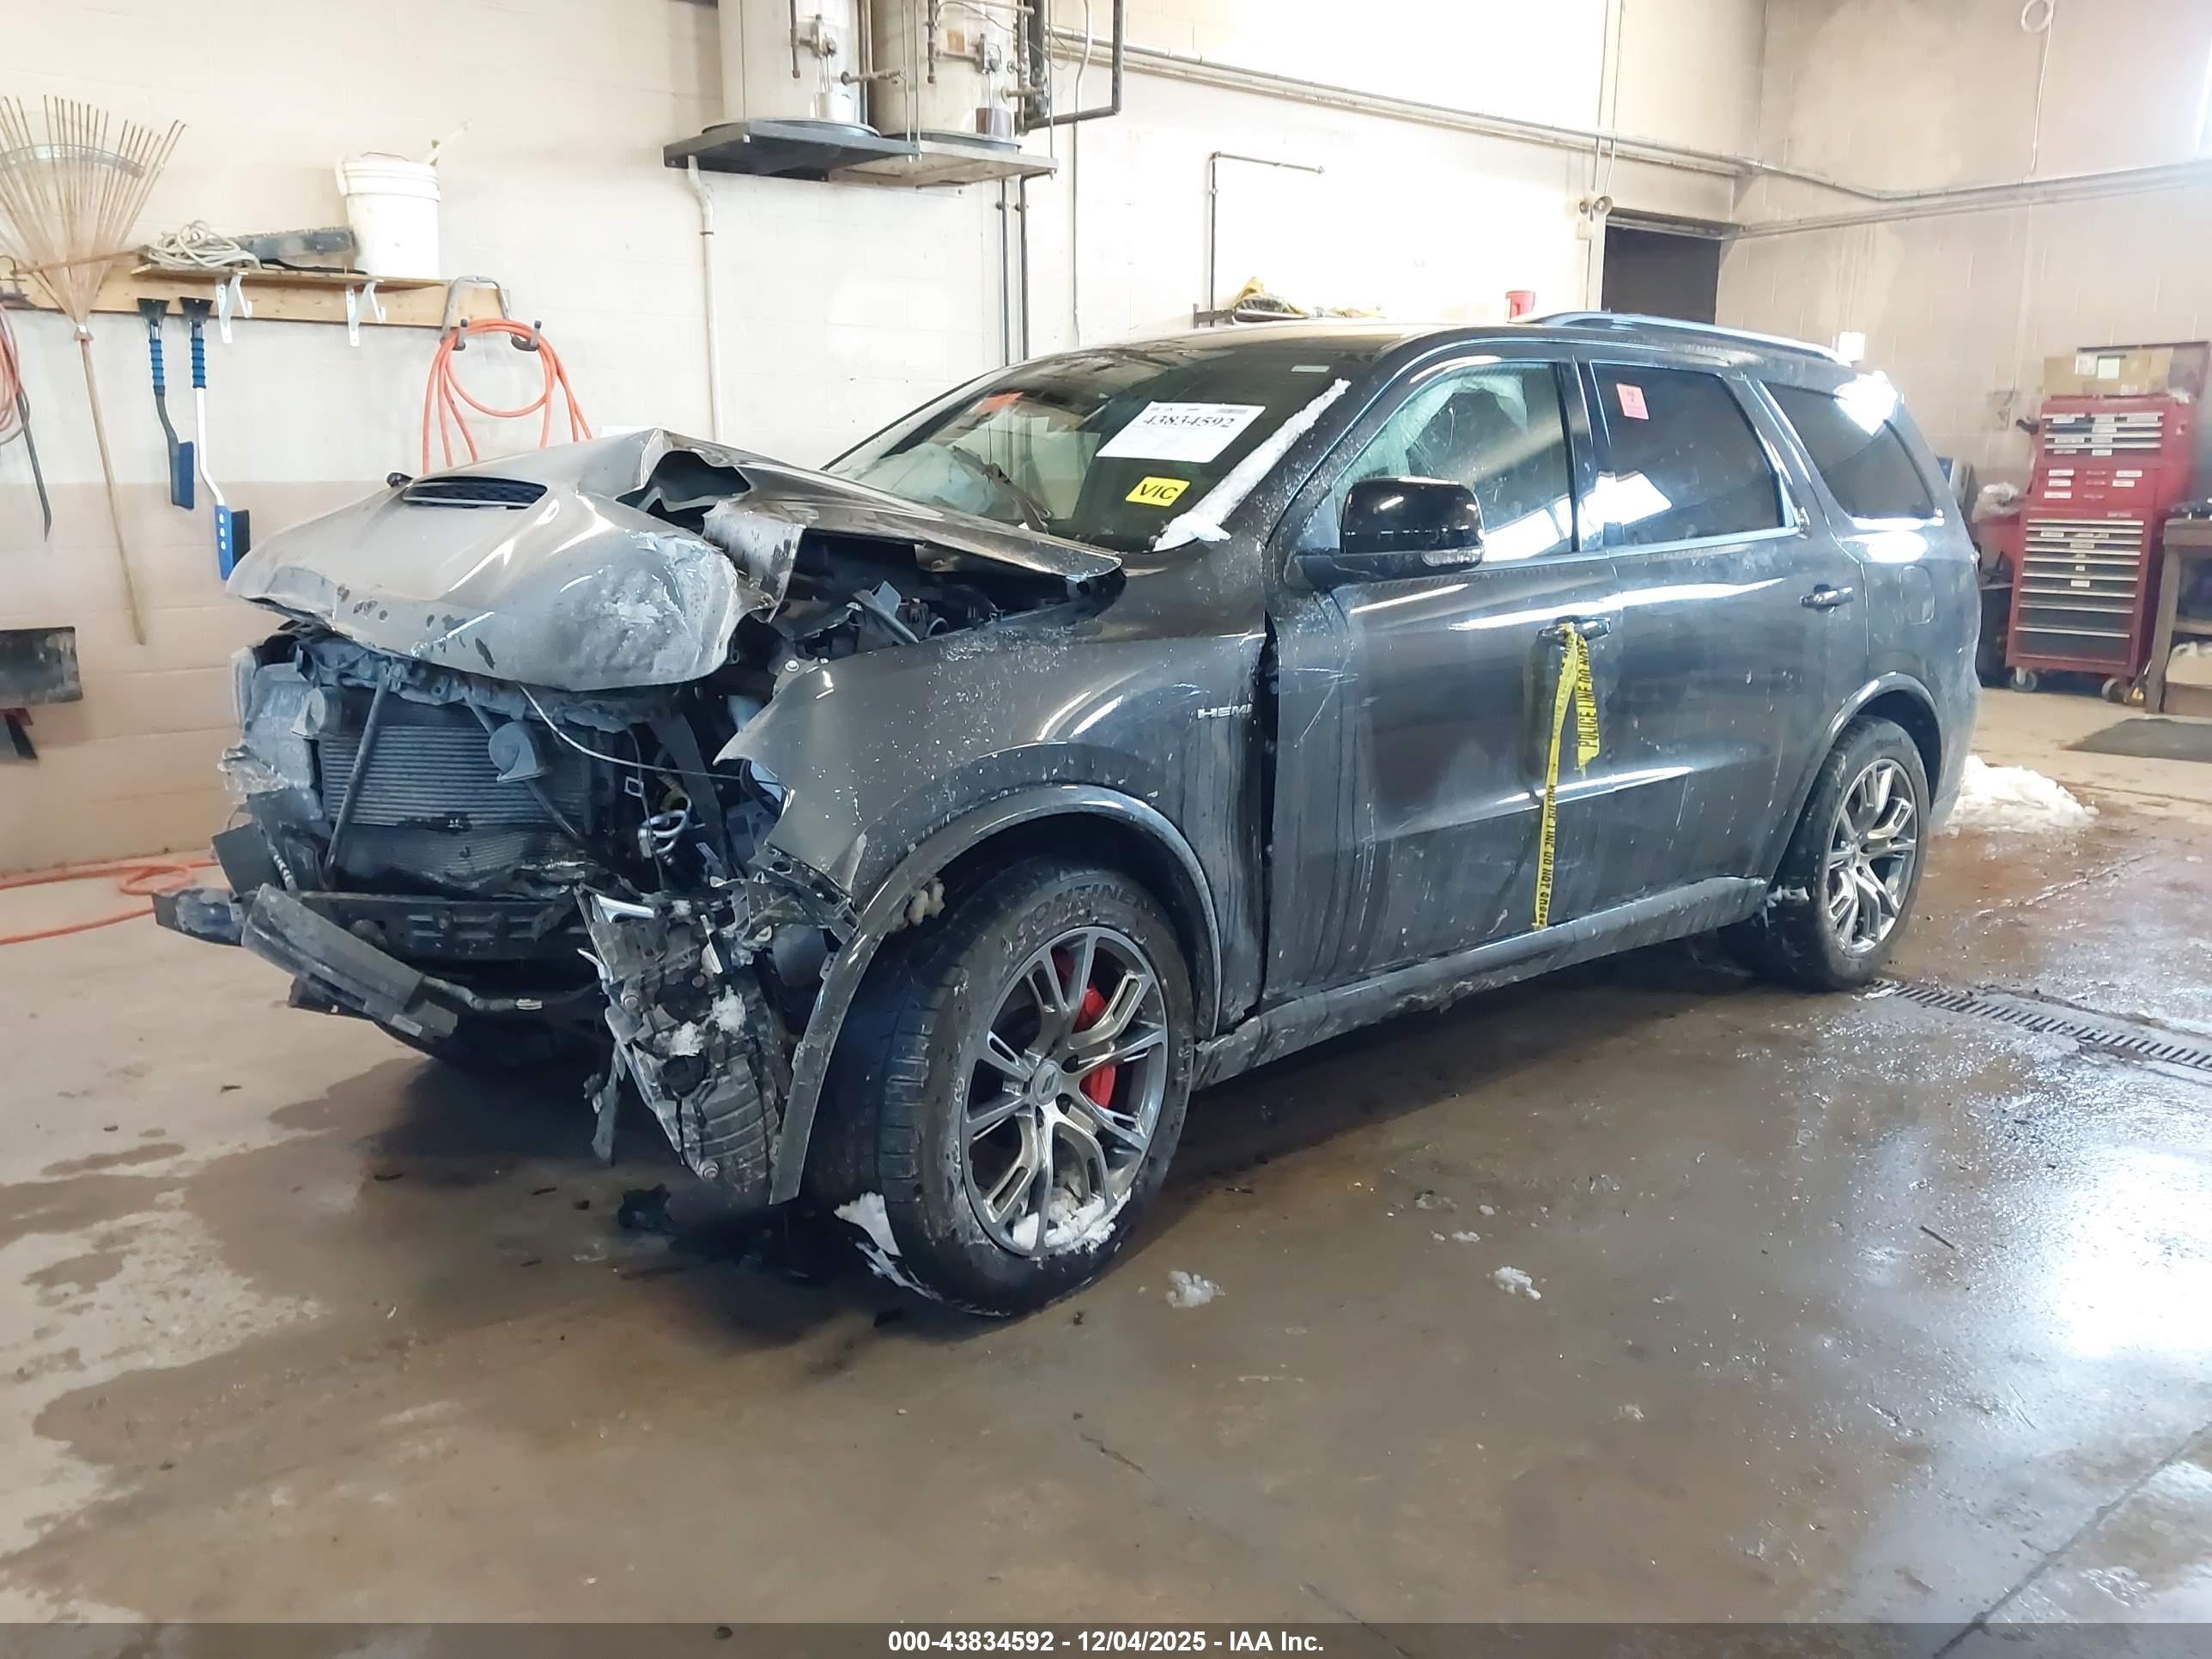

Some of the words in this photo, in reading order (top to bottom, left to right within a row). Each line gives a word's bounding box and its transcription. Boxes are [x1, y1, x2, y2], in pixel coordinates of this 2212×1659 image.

[1143, 415, 1235, 428] 43834592
[1139, 484, 1179, 500] VIC
[1577, 669, 1590, 682] DO
[1577, 686, 1595, 709] LINE
[1197, 703, 1253, 720] HEMI
[1578, 711, 1598, 748] POLICE
[1541, 868, 1553, 889] NOT
